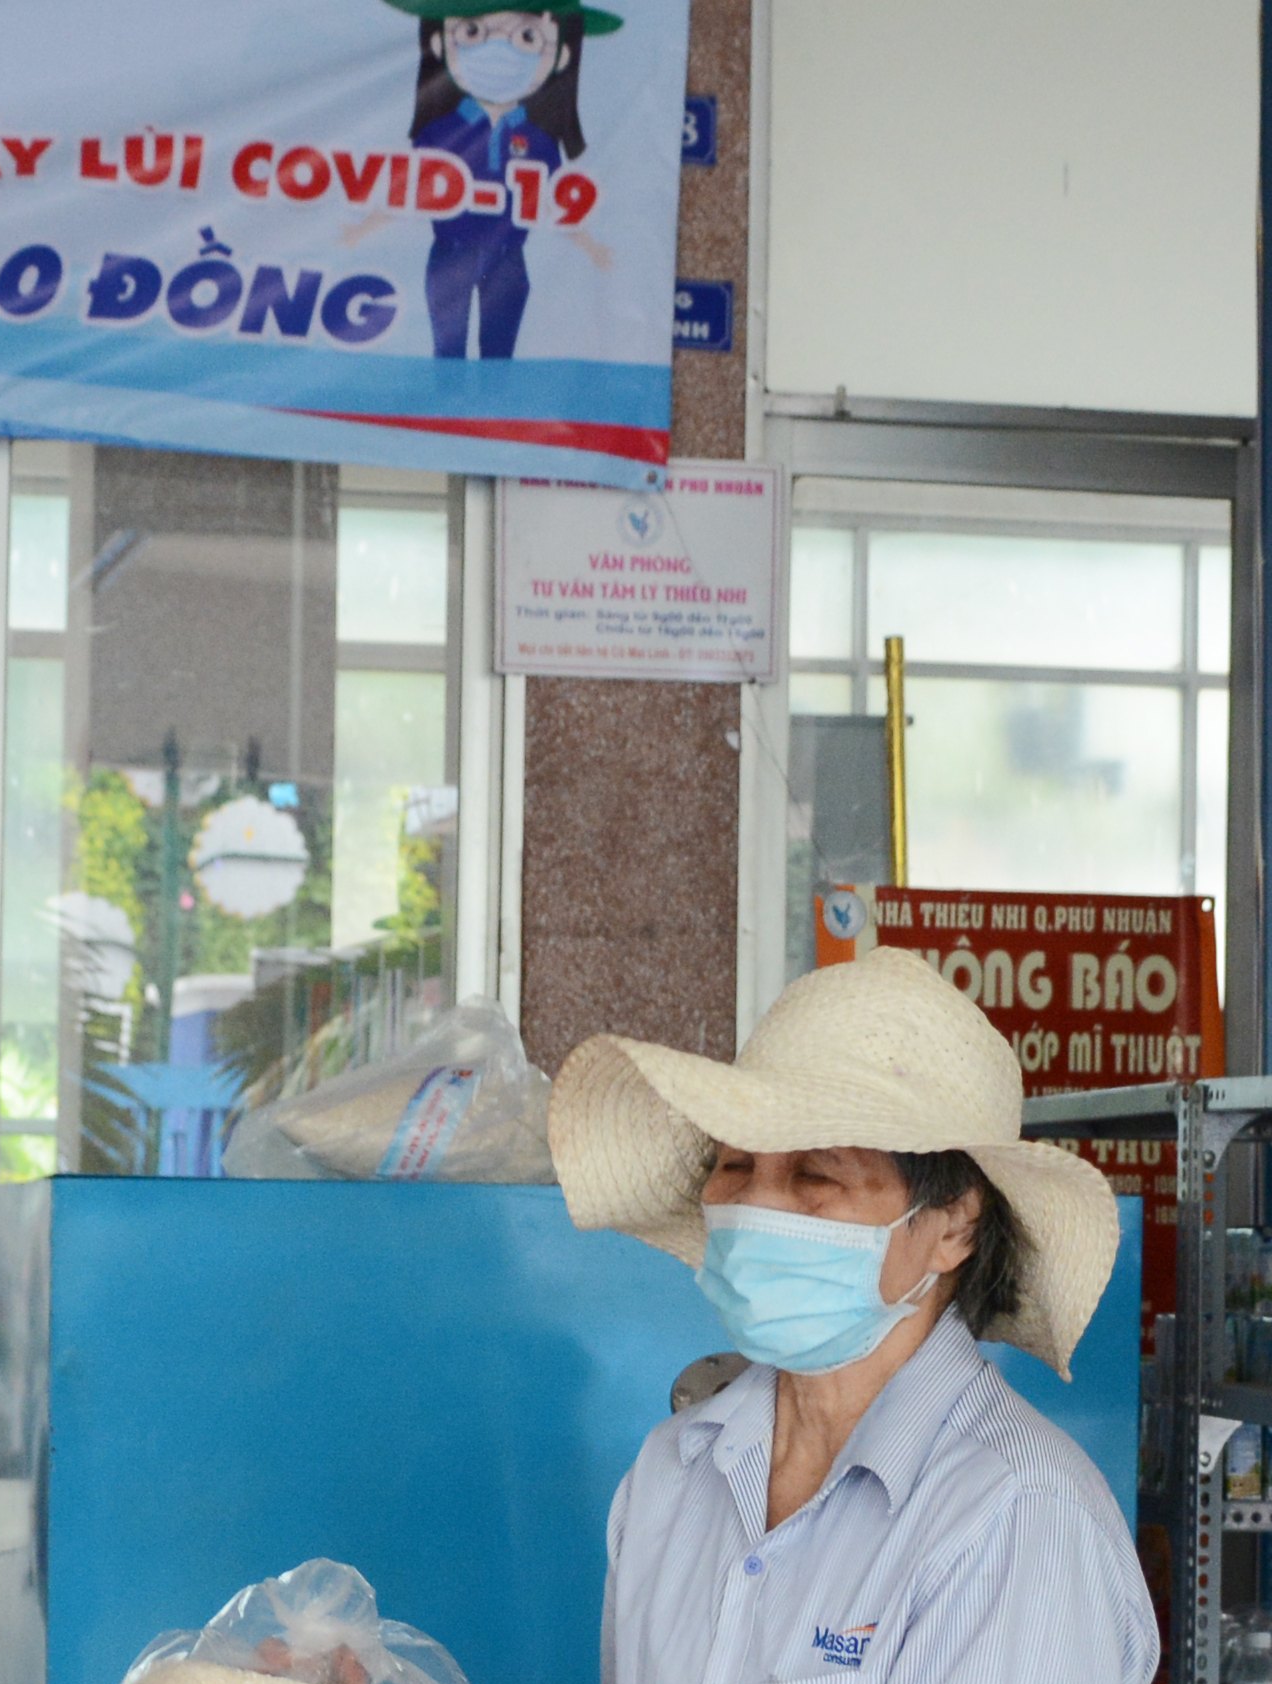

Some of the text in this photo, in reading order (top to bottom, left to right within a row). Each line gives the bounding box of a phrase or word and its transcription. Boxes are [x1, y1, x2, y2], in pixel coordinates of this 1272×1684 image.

[231, 140, 598, 226] COVID-19
[87, 225, 398, 343] ĐỒNG
[991, 903, 1028, 932] NHI
[1070, 939, 1178, 1015] BÁO
